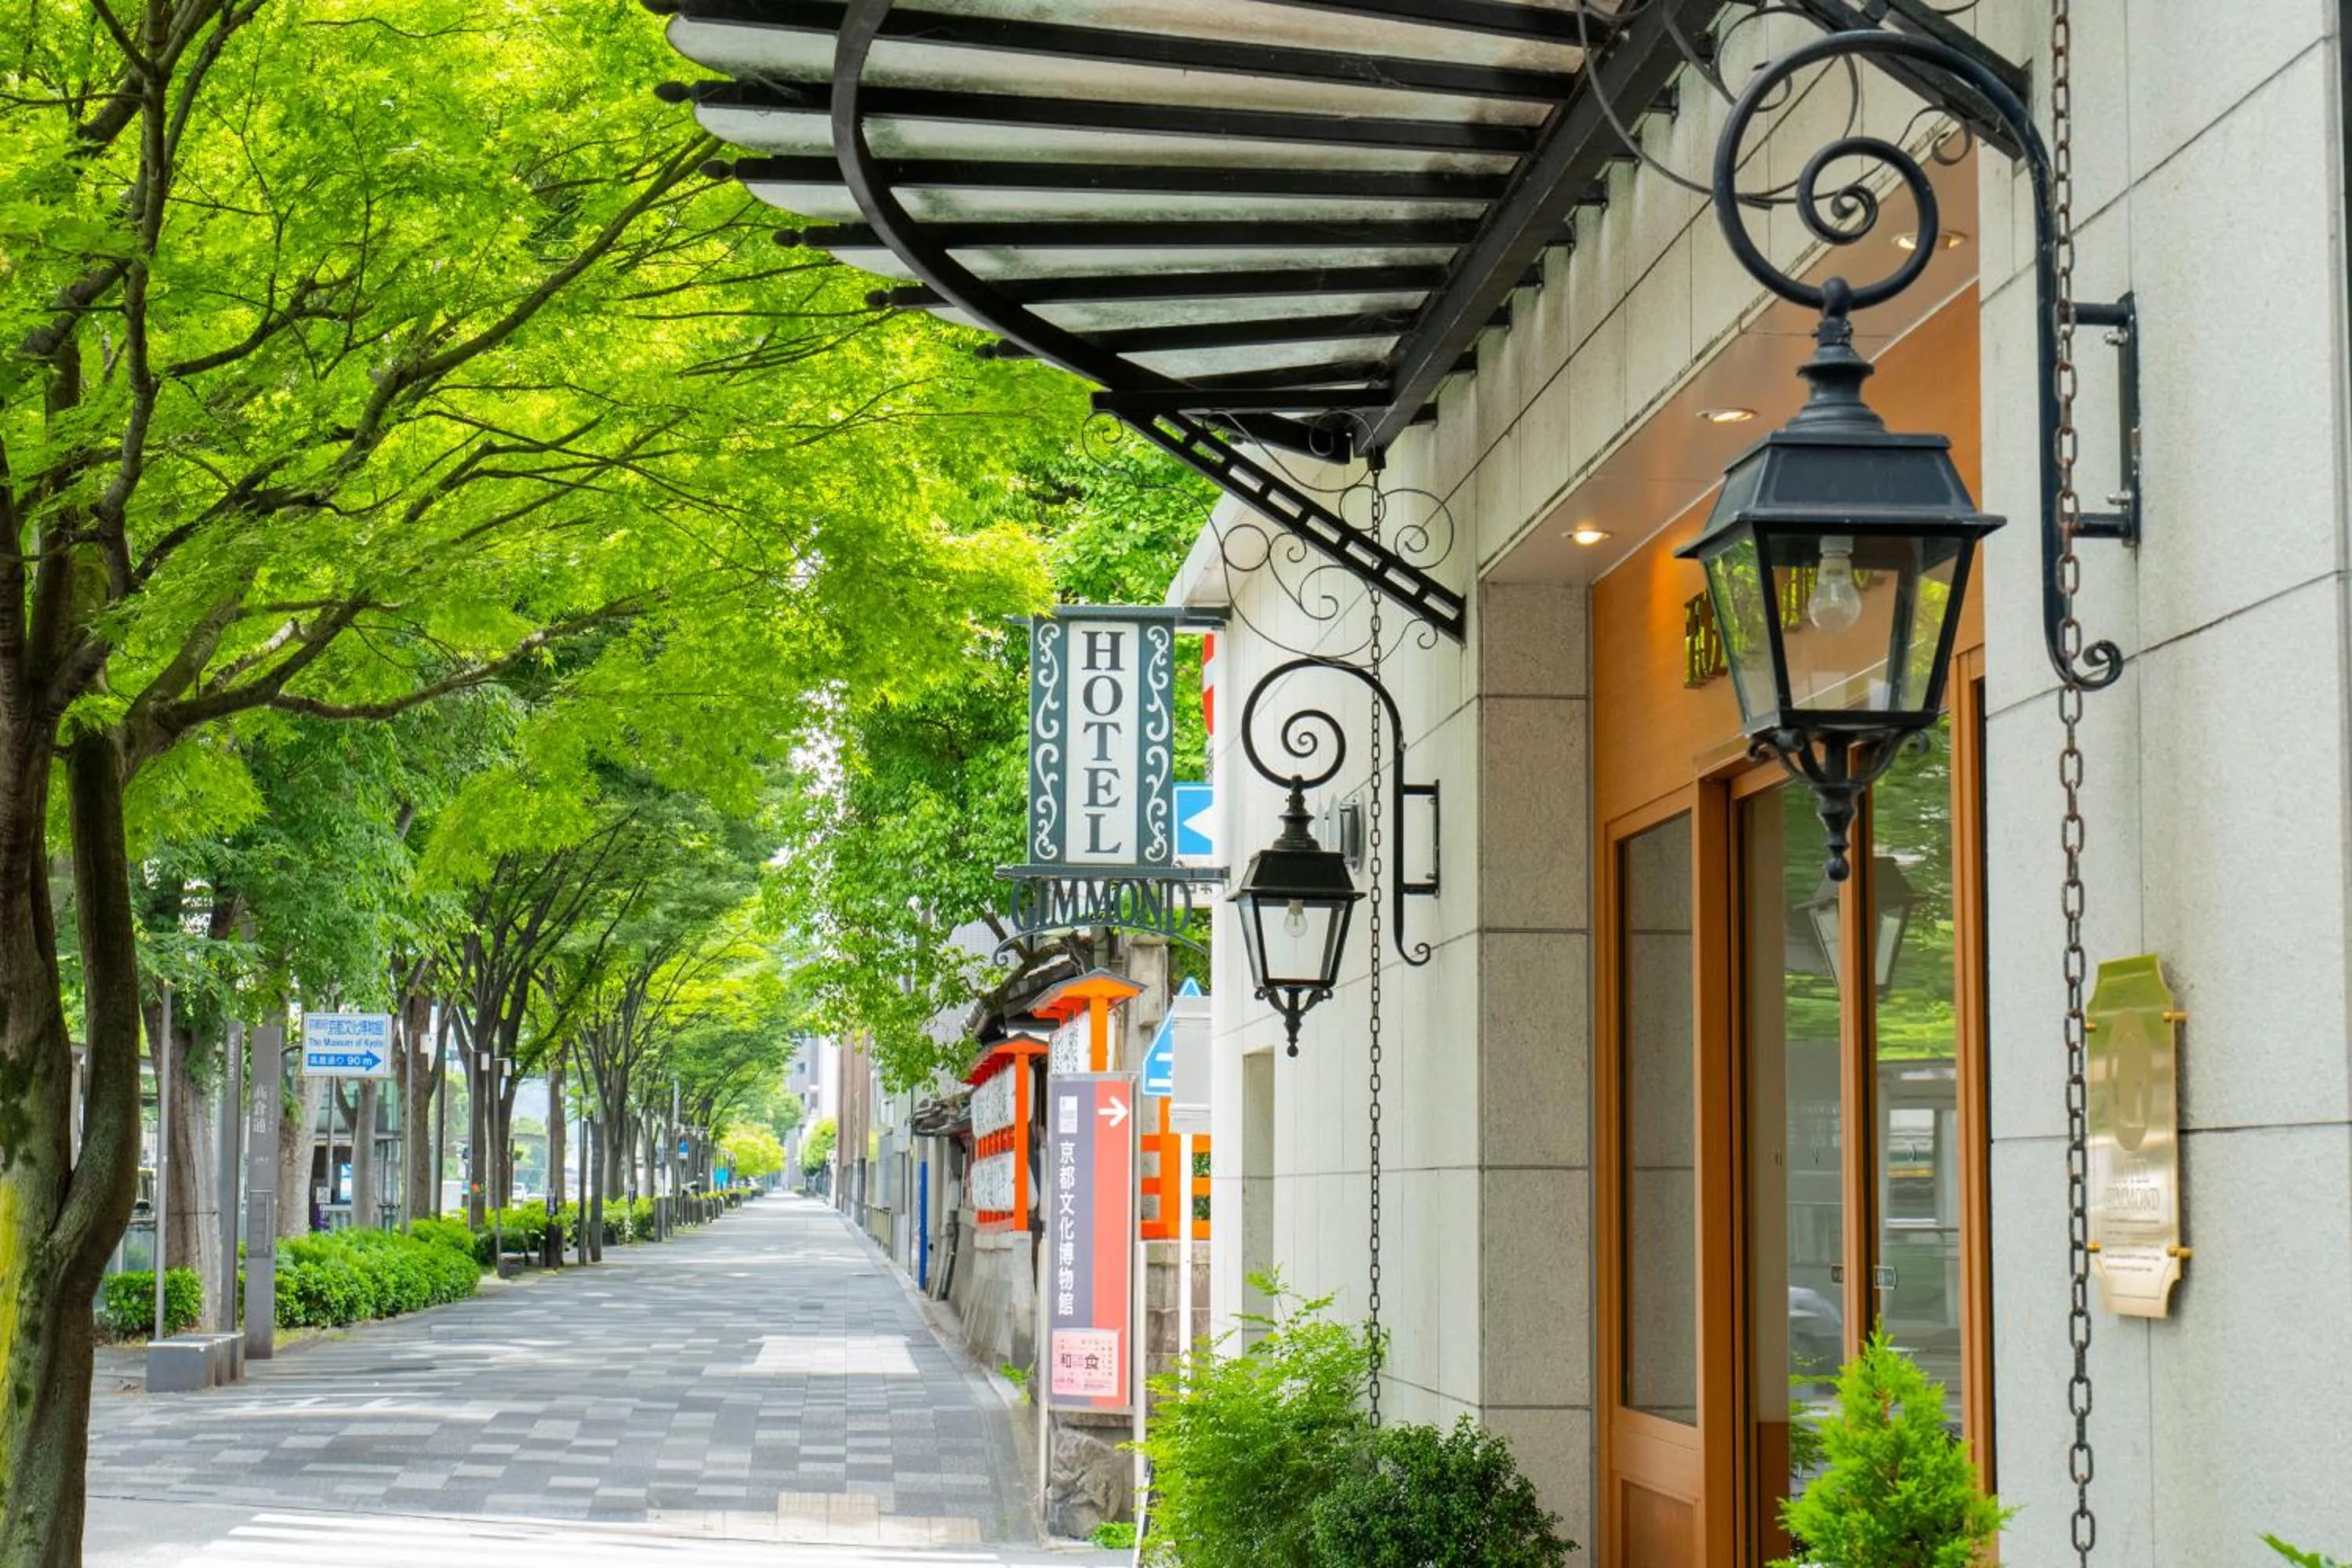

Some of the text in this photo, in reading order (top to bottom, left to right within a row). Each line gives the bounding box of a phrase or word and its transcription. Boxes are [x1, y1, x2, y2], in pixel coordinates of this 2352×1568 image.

[1081, 630, 1126, 854] HOTEL
[1011, 878, 1192, 933] GIMMOND
[1058, 1140, 1076, 1316] 京都文化博物館
